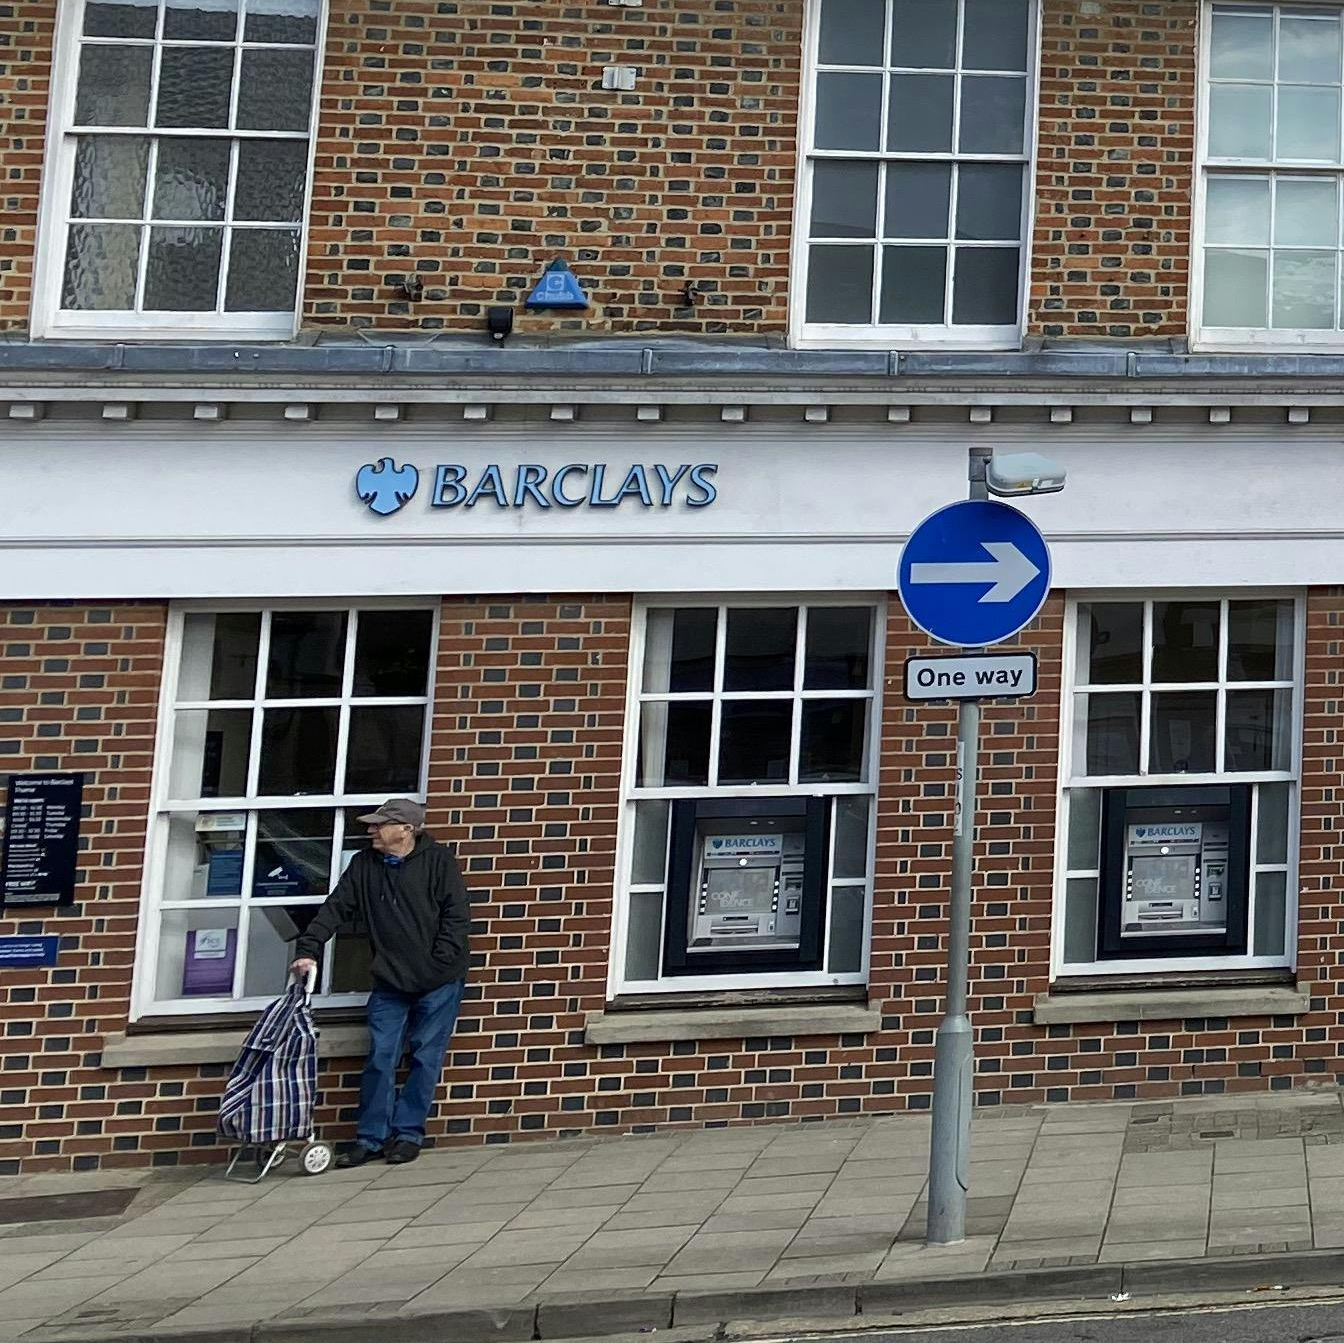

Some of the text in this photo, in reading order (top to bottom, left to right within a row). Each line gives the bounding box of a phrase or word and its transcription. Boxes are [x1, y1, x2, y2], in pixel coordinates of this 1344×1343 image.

[431, 464, 719, 507] BARCLAYS
[917, 668, 1023, 687] One way
[1147, 826, 1196, 836] BARCLAYS
[725, 838, 776, 847] BARCLAYS
